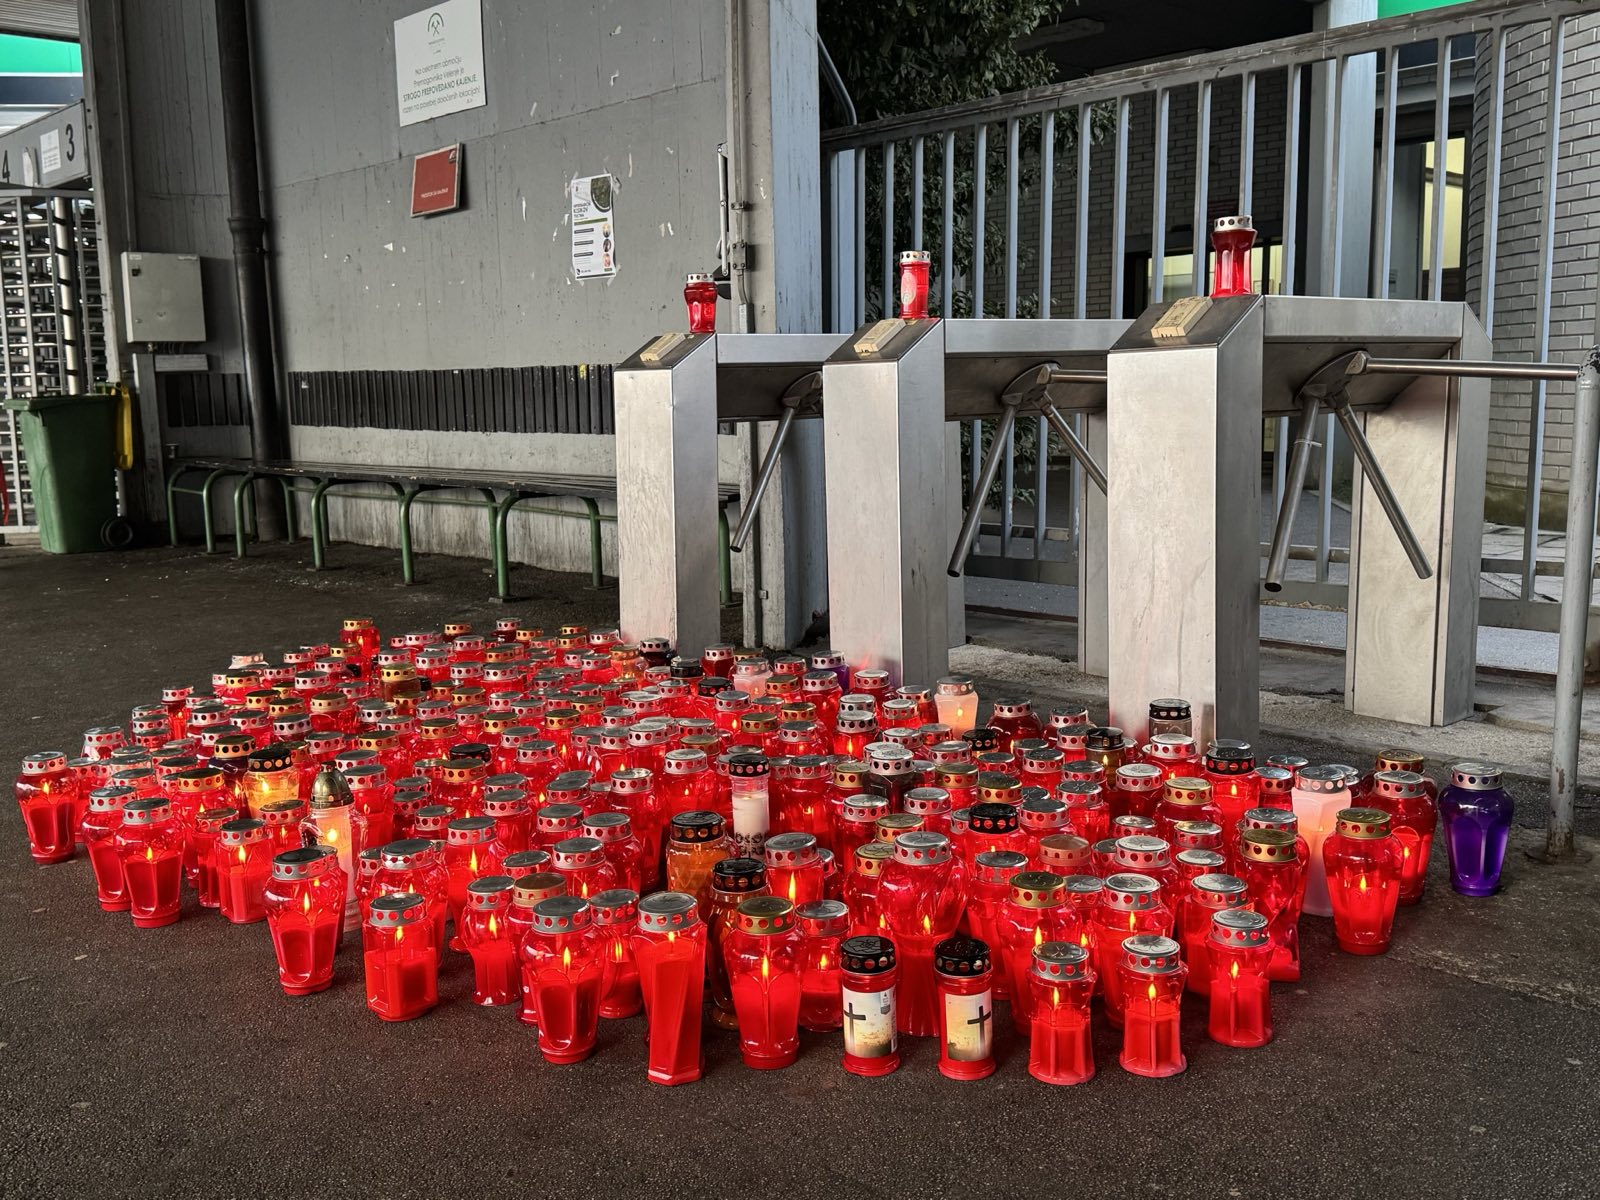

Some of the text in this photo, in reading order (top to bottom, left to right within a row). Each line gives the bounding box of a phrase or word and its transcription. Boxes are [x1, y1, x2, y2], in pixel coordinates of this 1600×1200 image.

[403, 73, 477, 102] STROGO PREPOVEDANO KAJENJE
[66, 124, 75, 161] 3
[2, 149, 10, 184] 4
